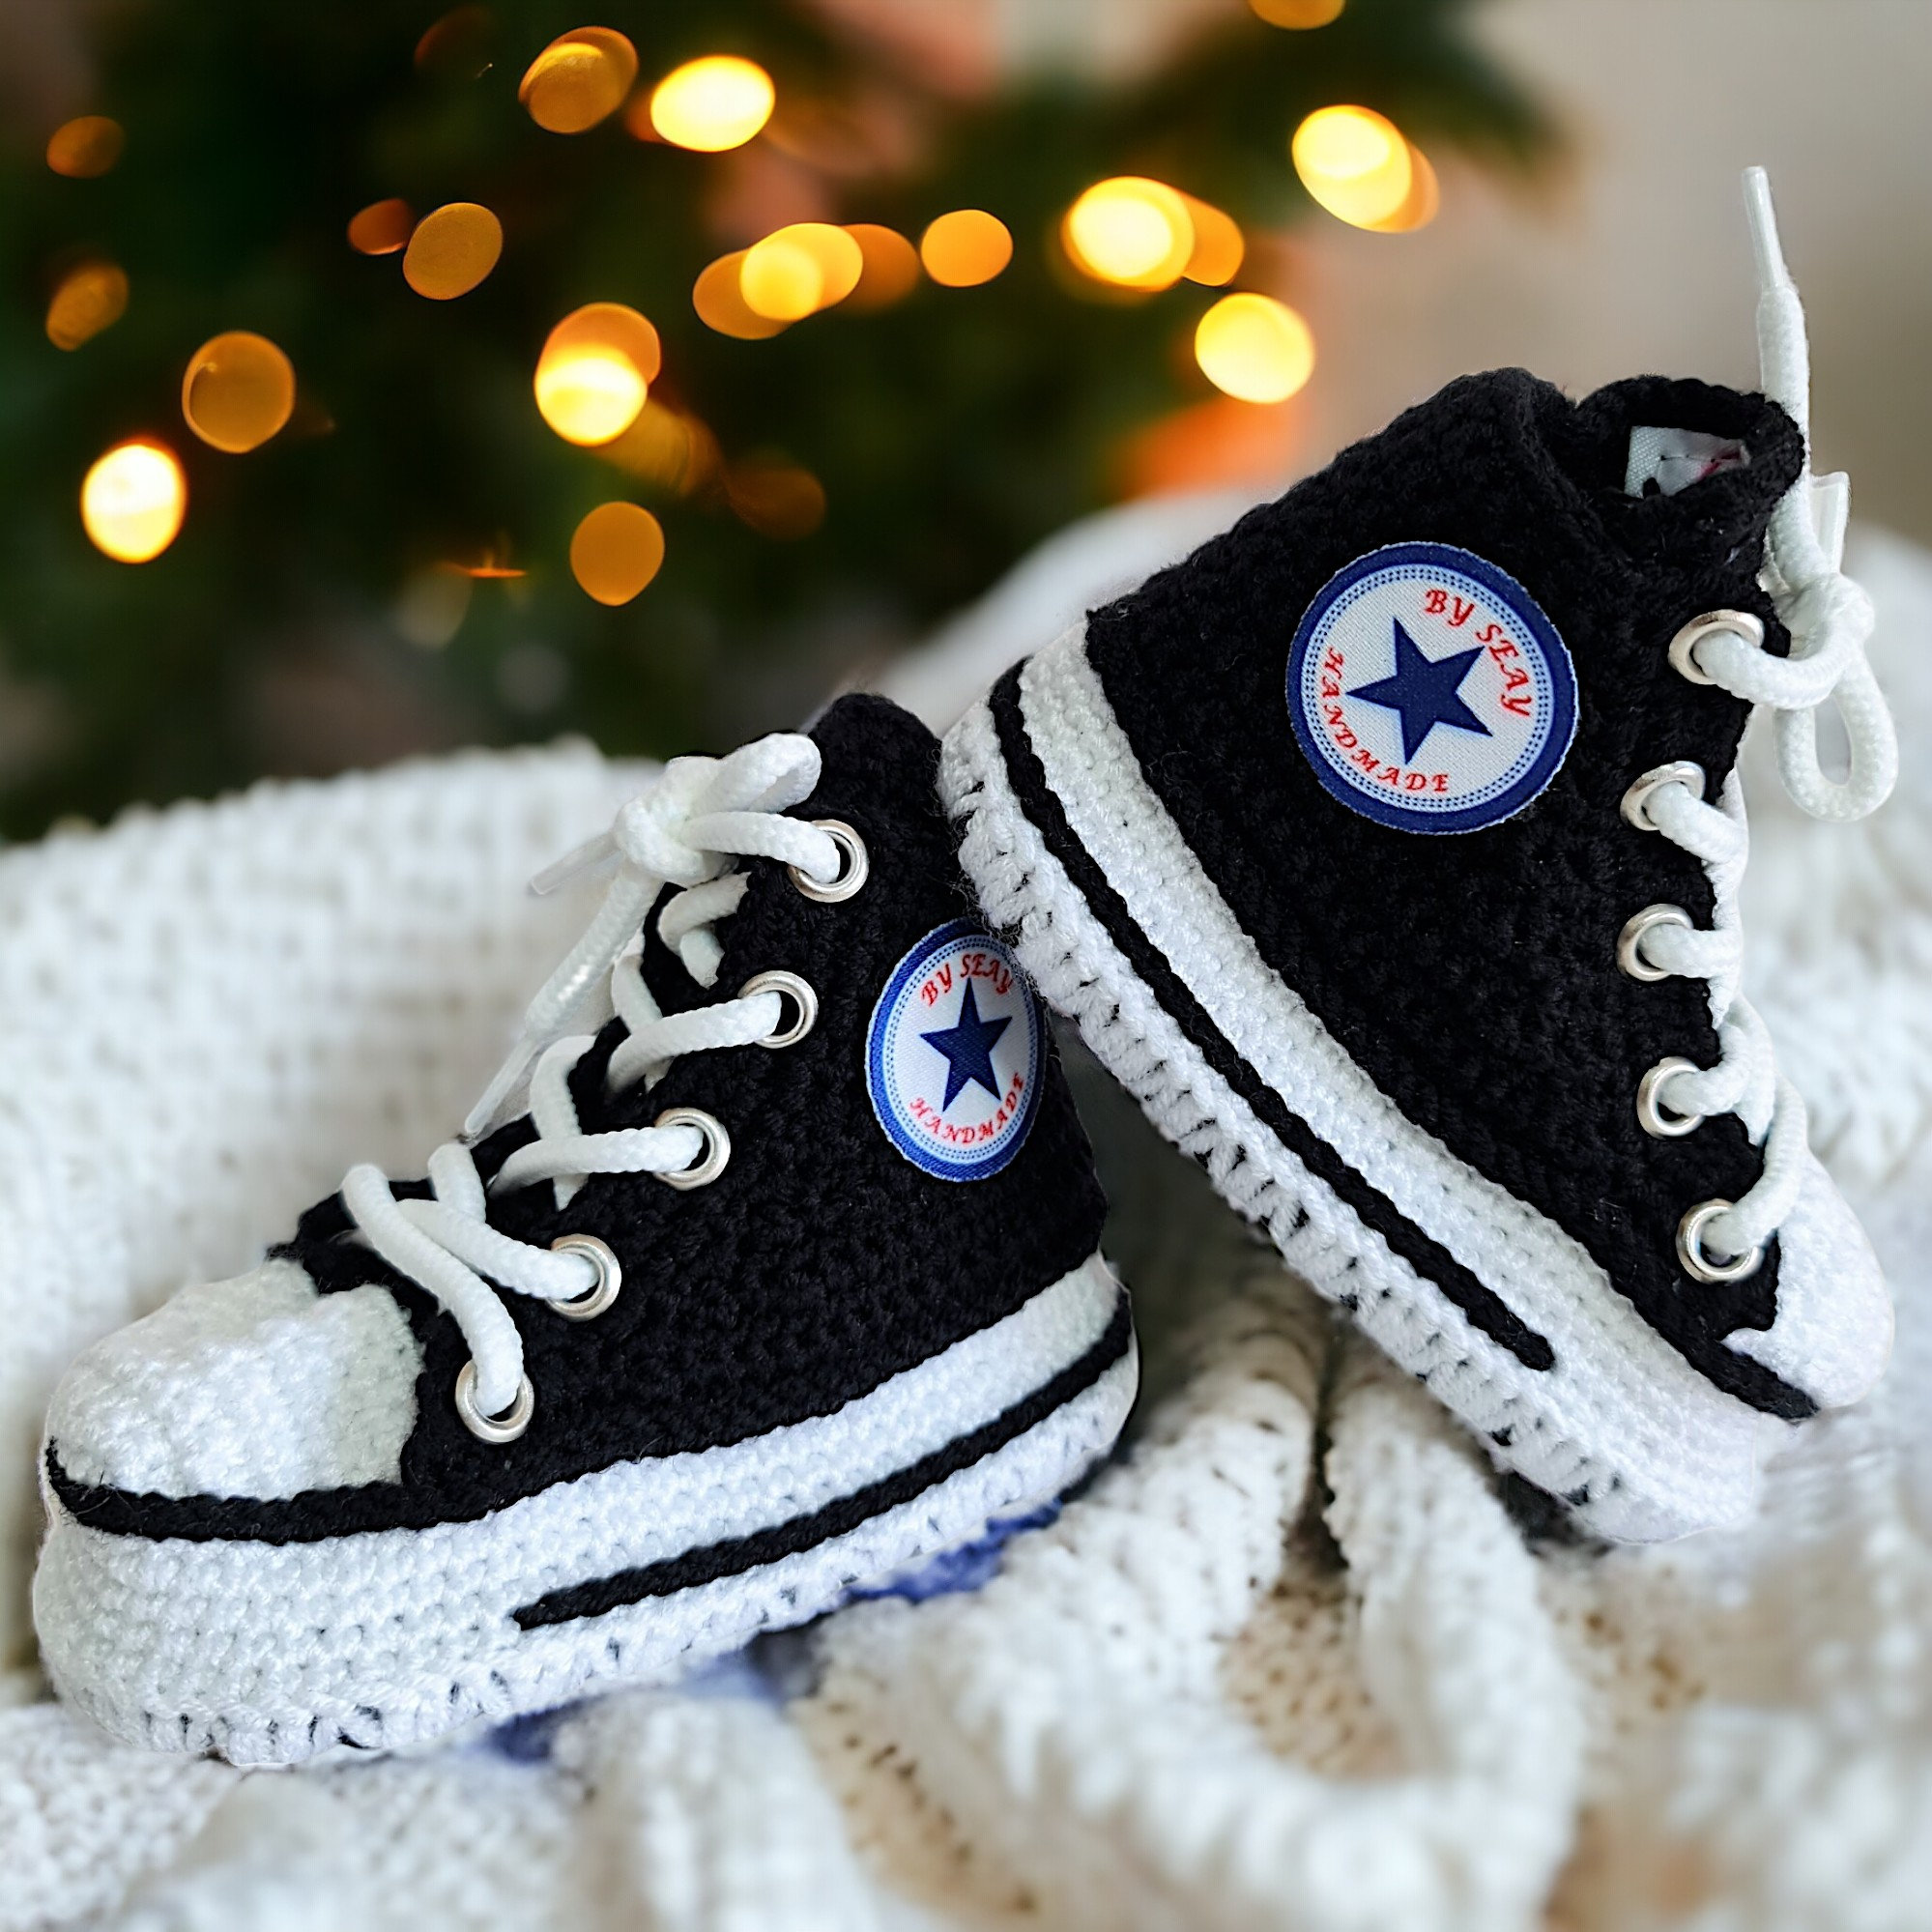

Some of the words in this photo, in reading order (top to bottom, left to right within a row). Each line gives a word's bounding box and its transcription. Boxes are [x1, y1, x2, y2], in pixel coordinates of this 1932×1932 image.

[1424, 588, 1475, 627] BY
[1476, 623, 1533, 717] SEAY
[1321, 647, 1450, 793] HANDMADE
[921, 963, 952, 1006] BY
[909, 1072, 1025, 1144] HANDMADE
